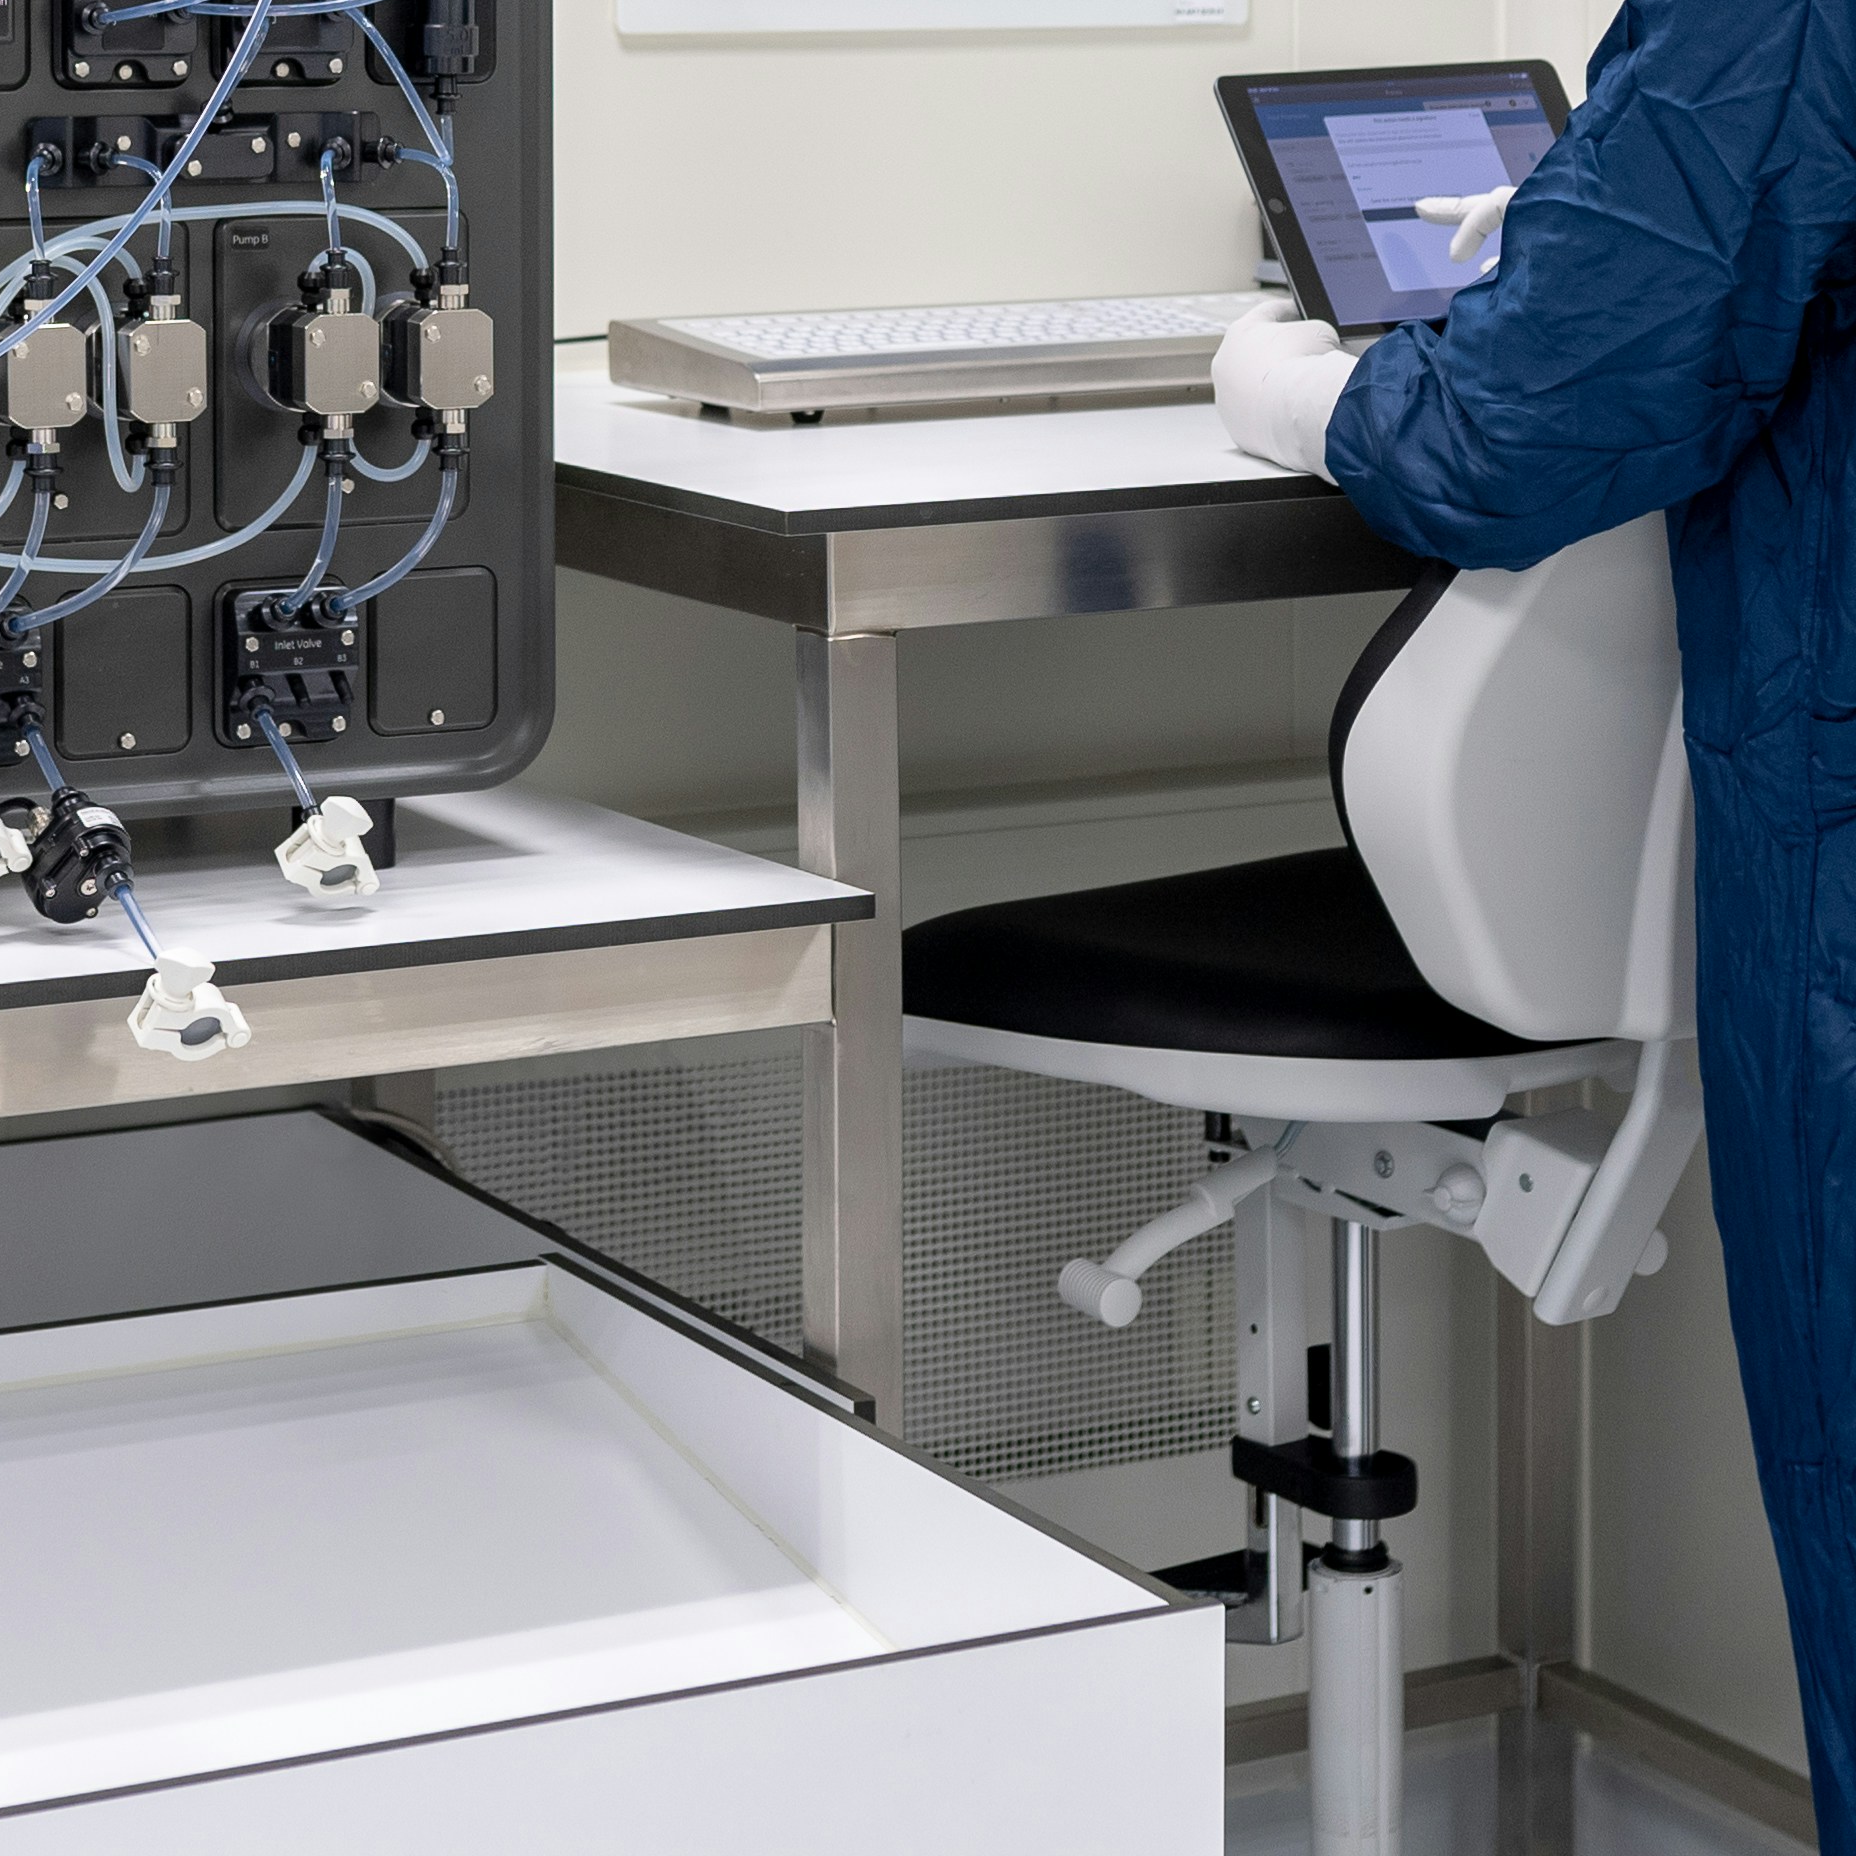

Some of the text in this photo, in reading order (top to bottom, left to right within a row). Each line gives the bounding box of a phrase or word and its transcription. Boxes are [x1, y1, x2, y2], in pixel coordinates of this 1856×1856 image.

[233, 234, 269, 246] Pump B
[274, 638, 322, 651] Inlet Valve
[249, 659, 260, 669] B1
[293, 656, 304, 666] B2
